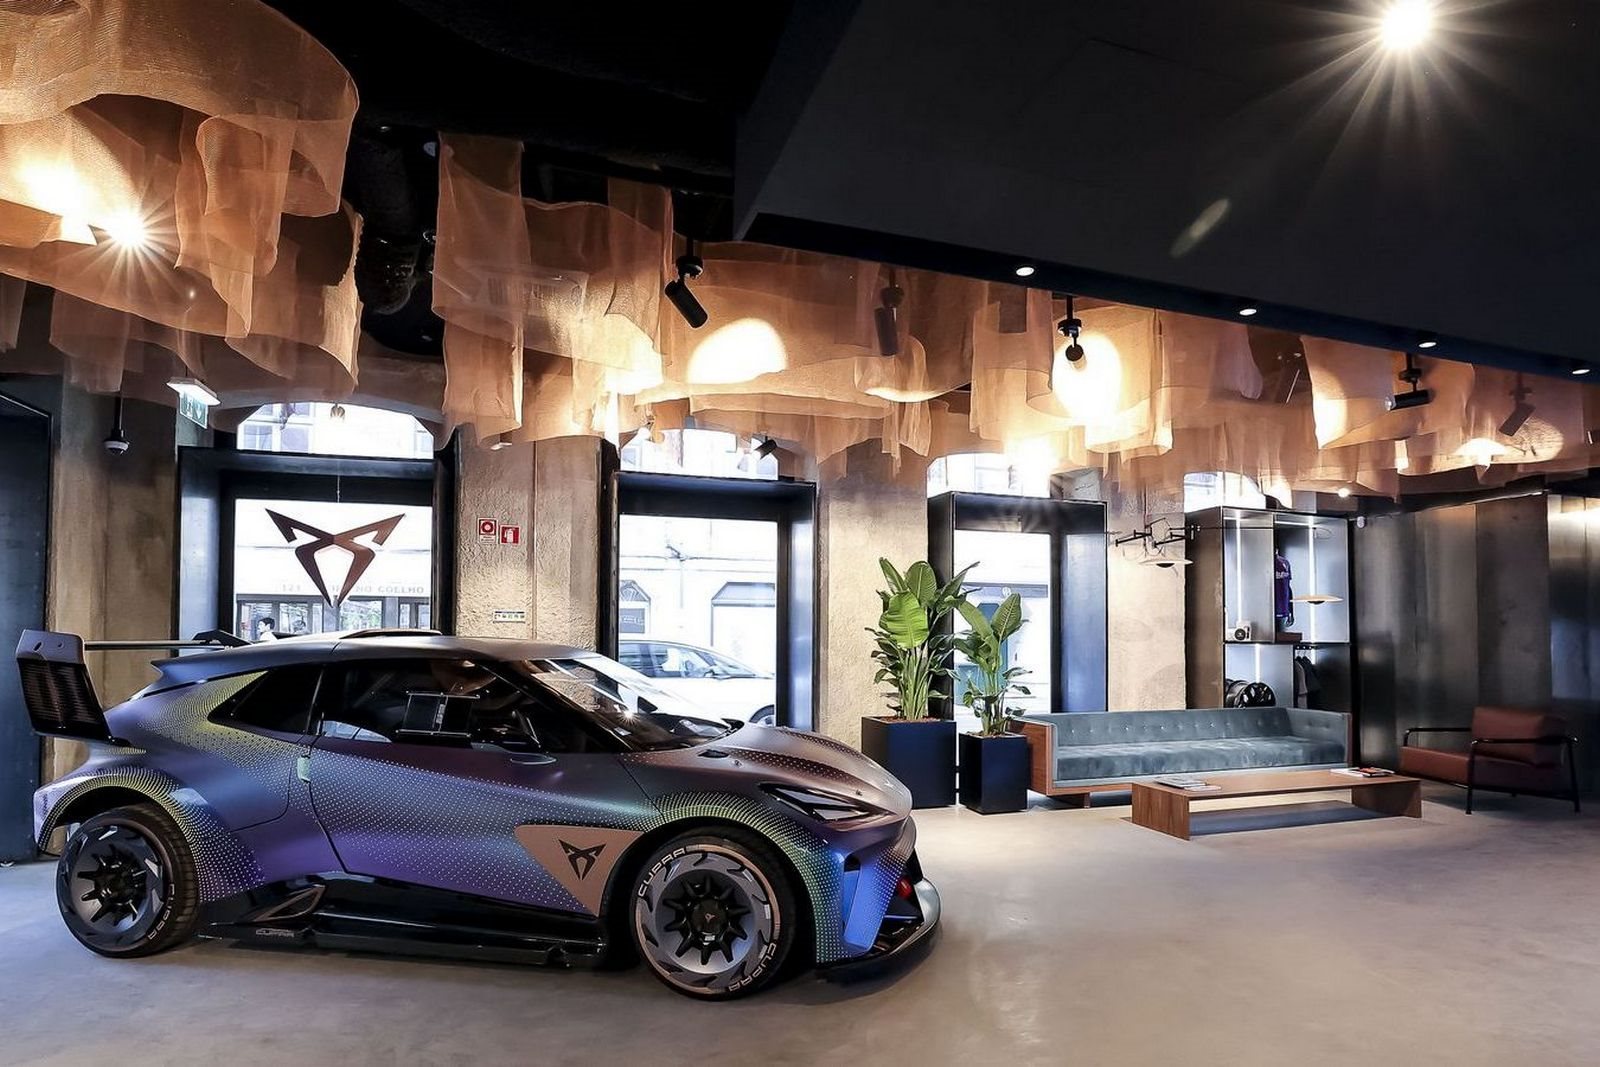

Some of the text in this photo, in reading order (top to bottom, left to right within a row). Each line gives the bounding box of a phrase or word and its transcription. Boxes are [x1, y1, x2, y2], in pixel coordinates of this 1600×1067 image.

[377, 585, 425, 594] COELHO
[637, 847, 687, 898] CUPRA
[729, 942, 777, 992] CUPRA
